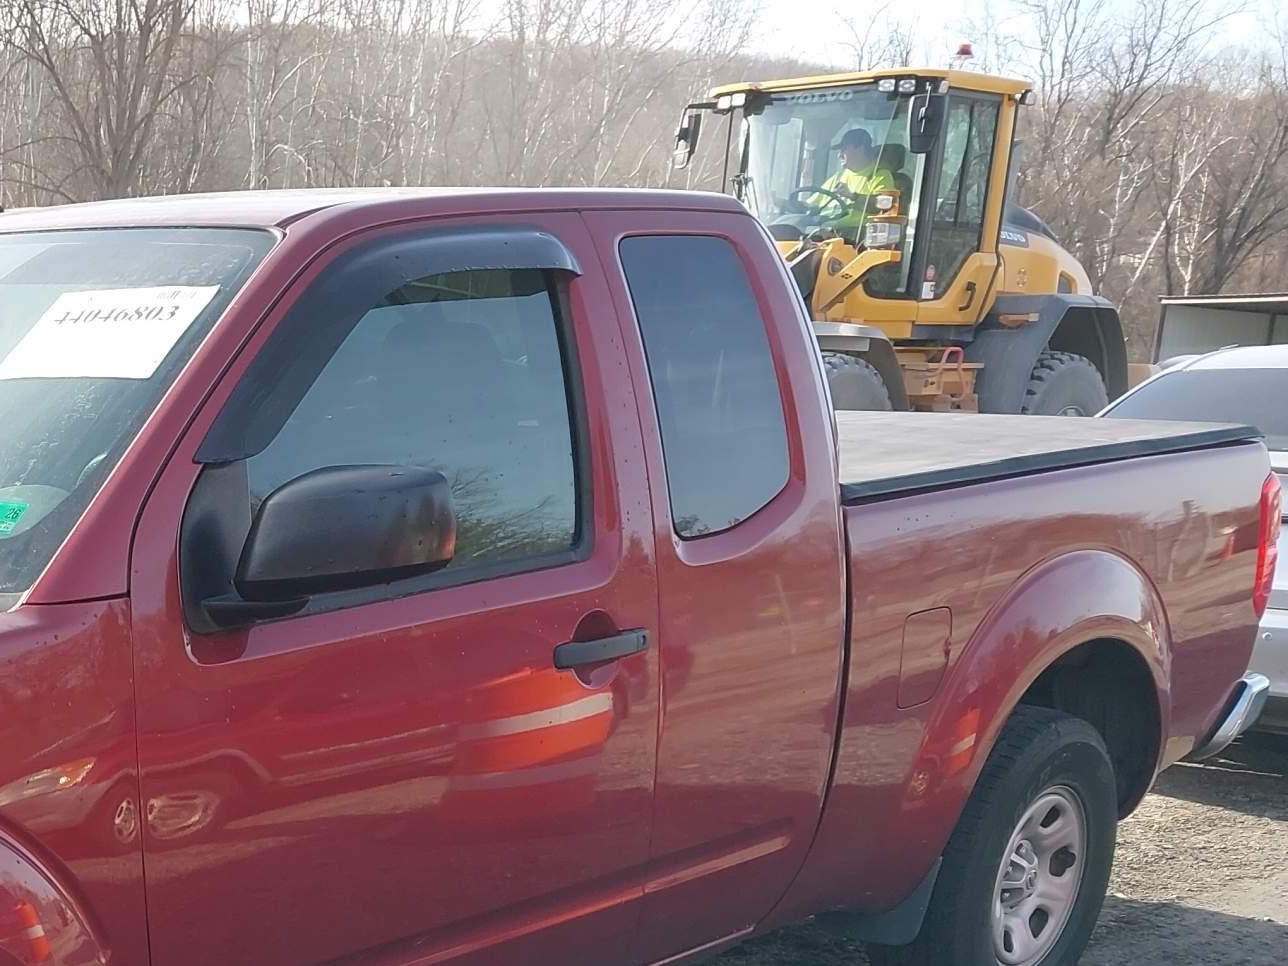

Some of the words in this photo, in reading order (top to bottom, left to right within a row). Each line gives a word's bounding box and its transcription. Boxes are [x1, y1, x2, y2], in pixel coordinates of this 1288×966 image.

[1000, 231, 1026, 242] OLVO
[53, 305, 180, 325] 44046803
[4, 507, 22, 520] 26
